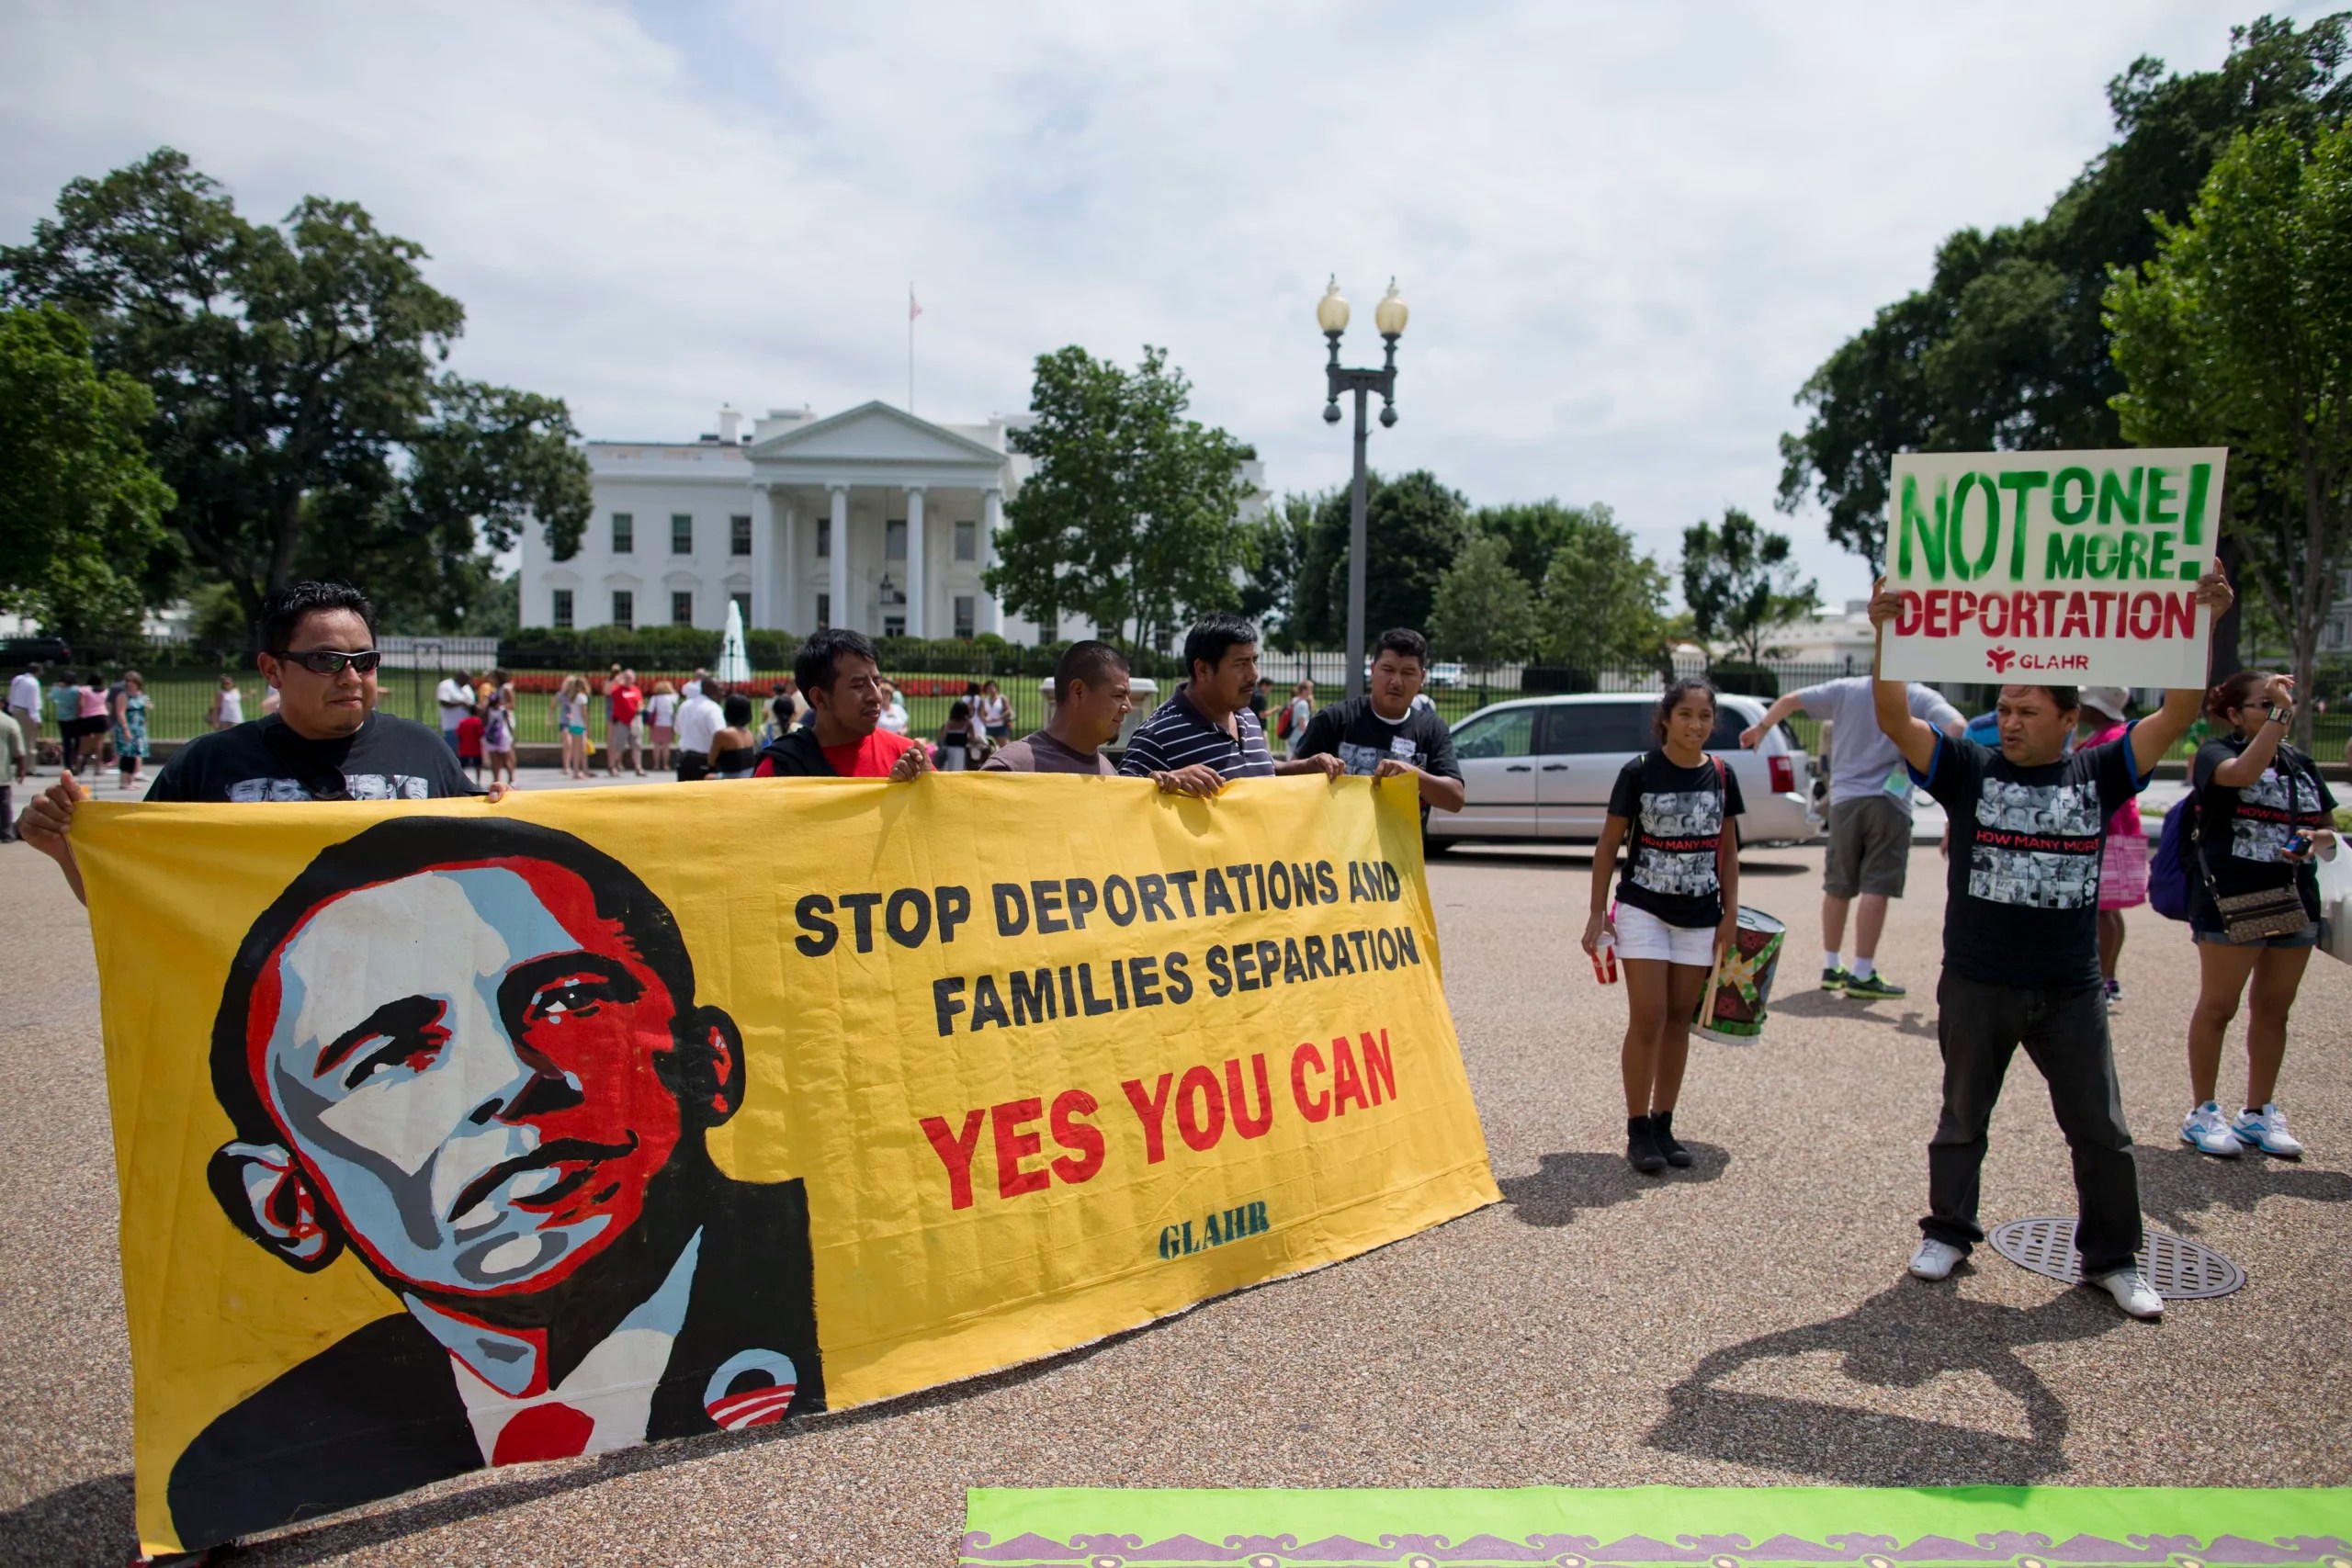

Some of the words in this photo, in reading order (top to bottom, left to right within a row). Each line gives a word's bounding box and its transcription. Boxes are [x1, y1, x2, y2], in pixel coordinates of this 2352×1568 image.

[1898, 470, 2049, 581] NOT
[1895, 589, 2196, 639] DEPORTATION
[2018, 654, 2090, 671] GLAHR
[1642, 835, 1664, 849] HOW
[1666, 840, 1700, 851] MANY
[1702, 838, 1720, 849] MO
[1976, 829, 2012, 846] HOW
[2014, 835, 2062, 852] MANY
[794, 886, 971, 958] STOP
[991, 860, 1339, 937] DEPORTATIONS
[1348, 861, 1401, 903] AND
[933, 952, 1193, 1037] FAMILIES
[1206, 927, 1420, 998] SEPARATION
[920, 1089, 1105, 1210] YES
[1122, 1054, 1272, 1165] YOU
[1291, 1028, 1396, 1123] CAN
[1158, 1200, 1270, 1261] GLAHR
